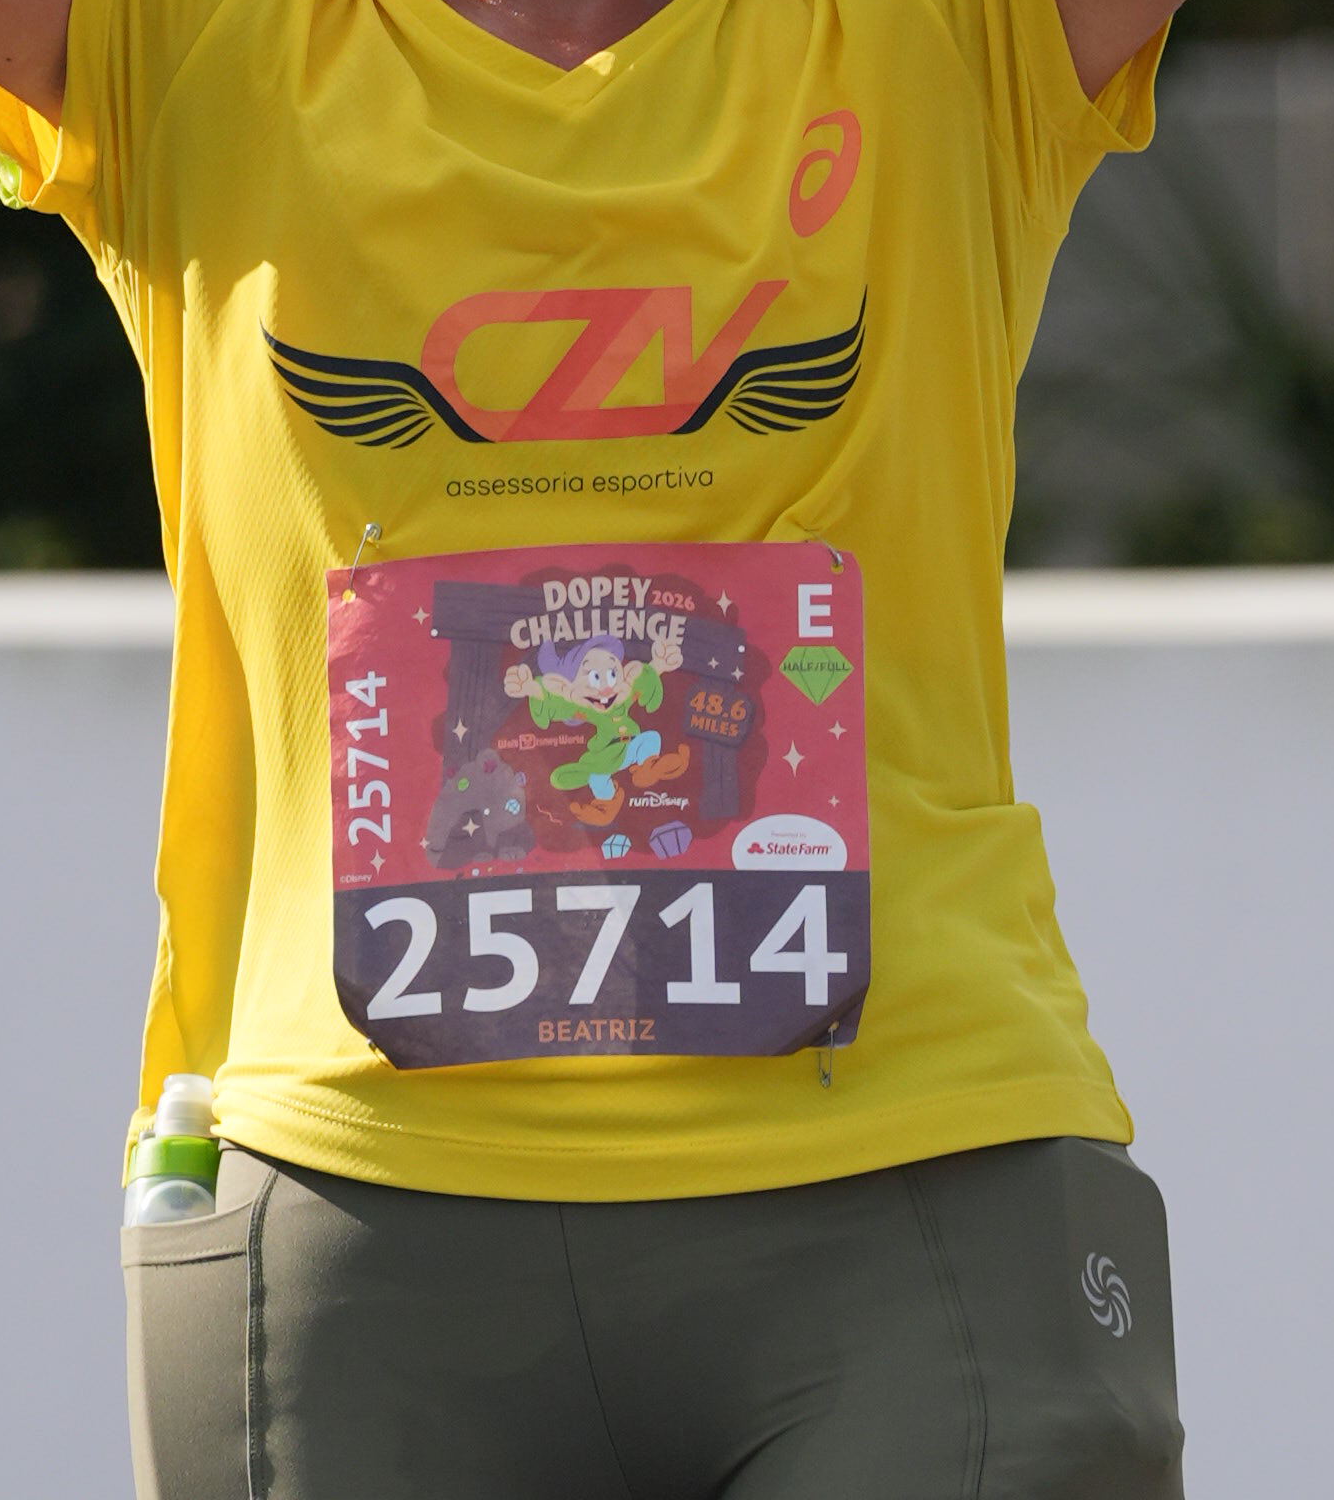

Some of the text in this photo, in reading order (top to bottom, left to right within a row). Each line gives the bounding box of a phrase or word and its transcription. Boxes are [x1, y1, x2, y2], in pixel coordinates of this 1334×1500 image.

[446, 465, 714, 497] assessoria esportiva
[542, 576, 696, 612] DOPEY 2026
[797, 584, 833, 638] E
[510, 608, 687, 650] CHALLENGE
[783, 661, 850, 673] HALF/FULL
[689, 691, 747, 721] 48.6
[690, 714, 740, 738] MILES
[346, 671, 391, 846] 25714
[363, 881, 849, 1022] 25714
[537, 1019, 656, 1044] BEATRIZ
